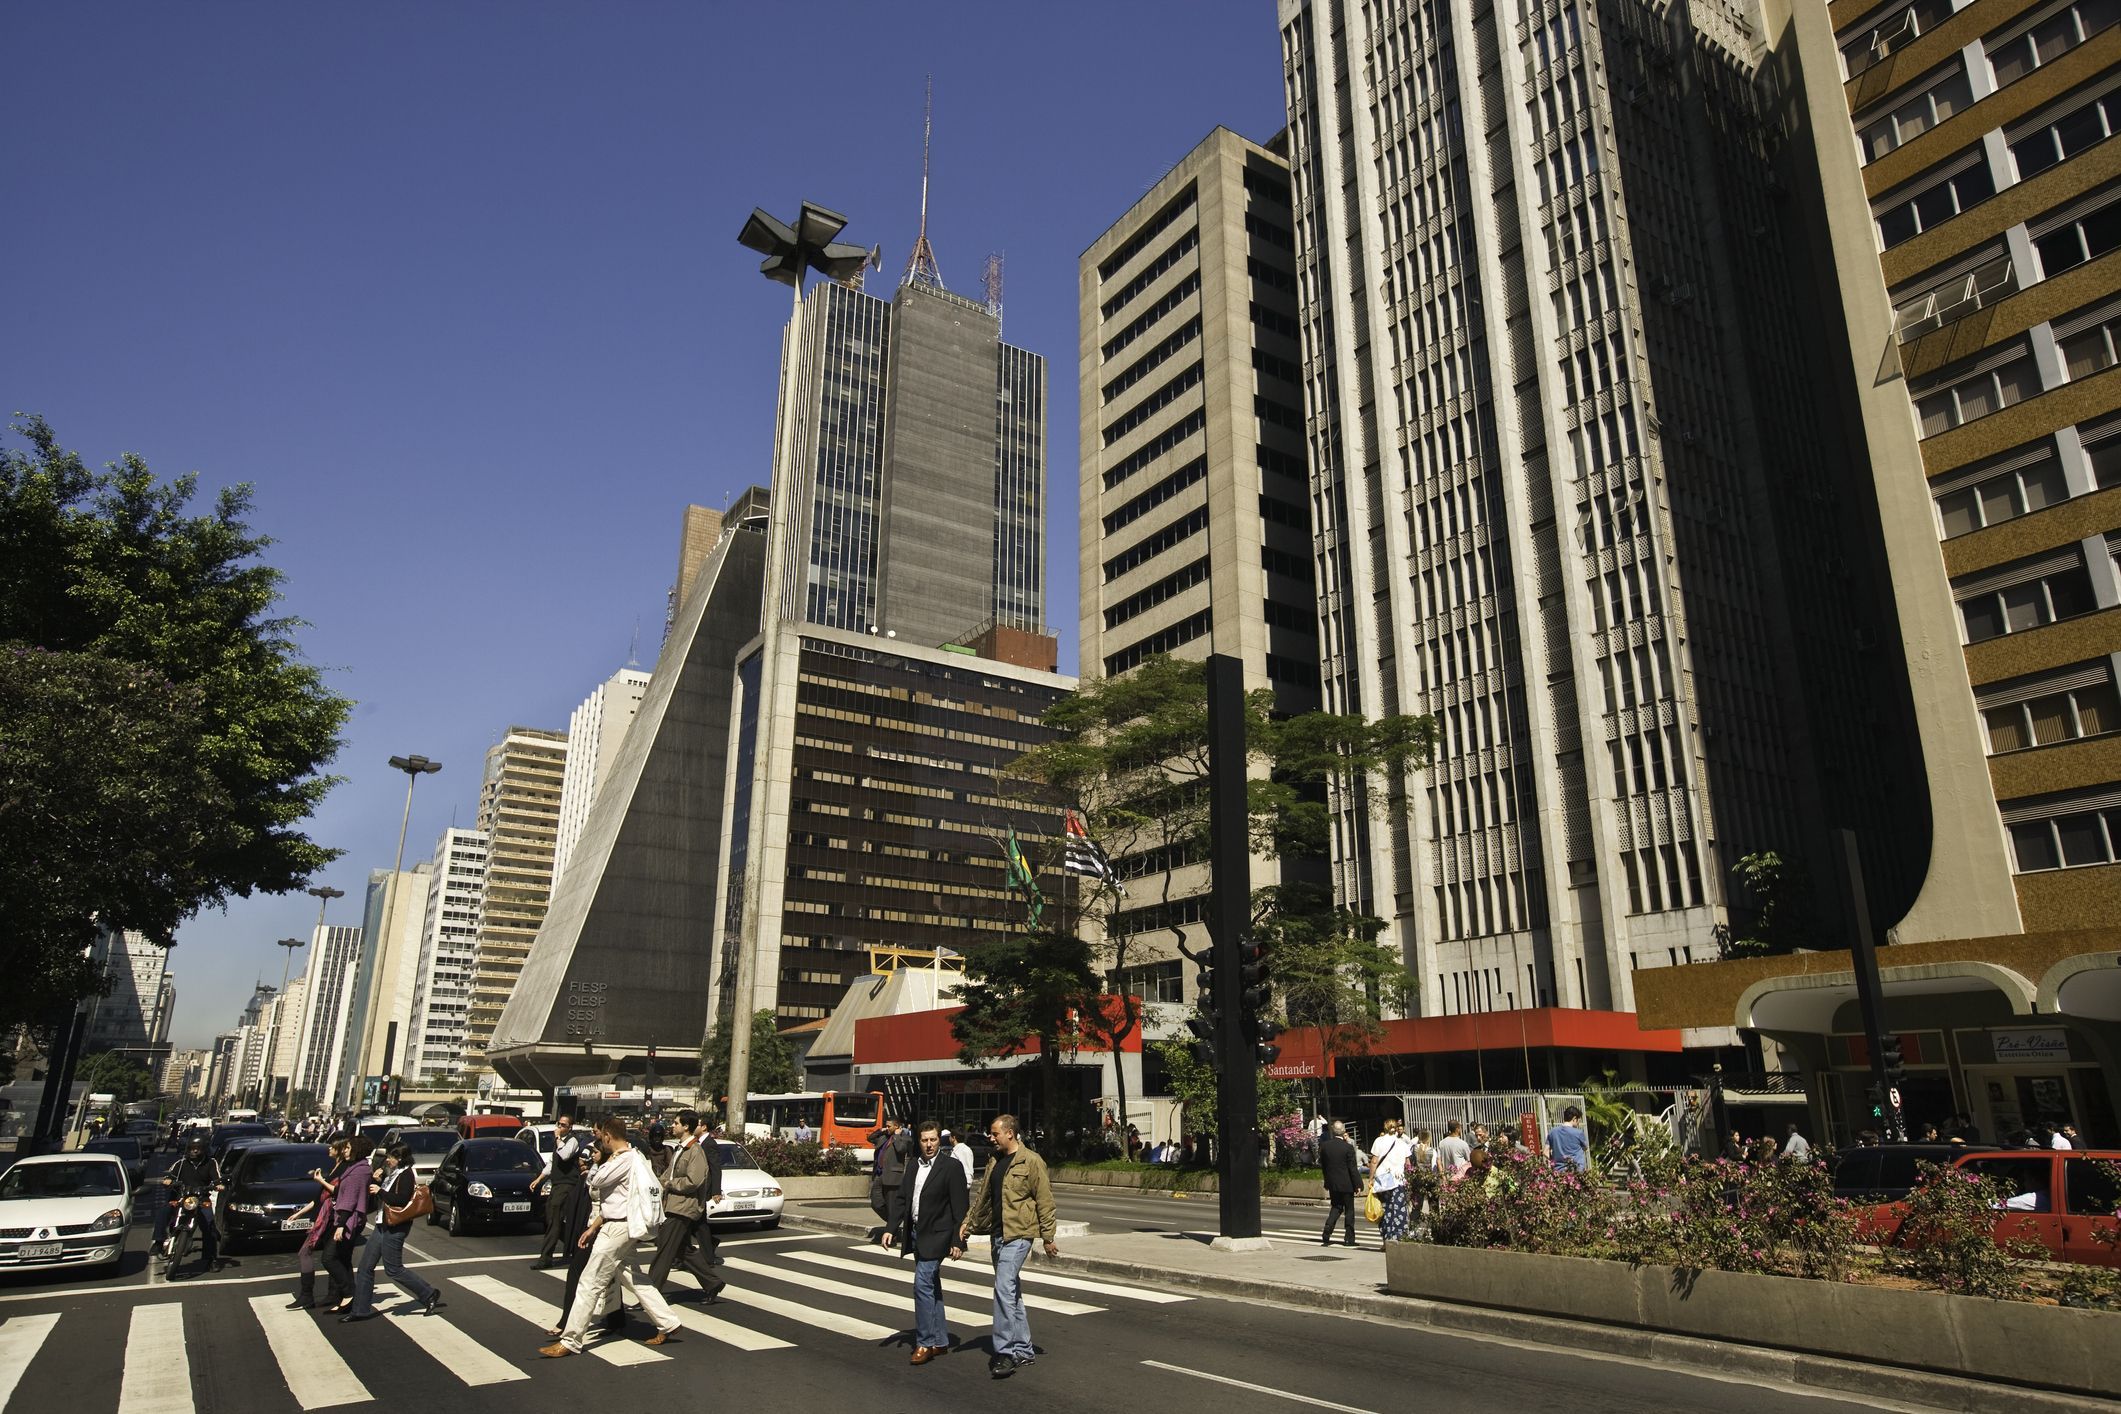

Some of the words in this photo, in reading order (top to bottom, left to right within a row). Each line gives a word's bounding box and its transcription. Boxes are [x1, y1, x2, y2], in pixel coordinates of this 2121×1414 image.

[570, 981, 608, 993] FIESP
[568, 995, 607, 1007] CIESP
[568, 1010, 597, 1021] SESI
[1268, 1061, 1315, 1076] Santander
[39, 1247, 60, 1255] 9485
